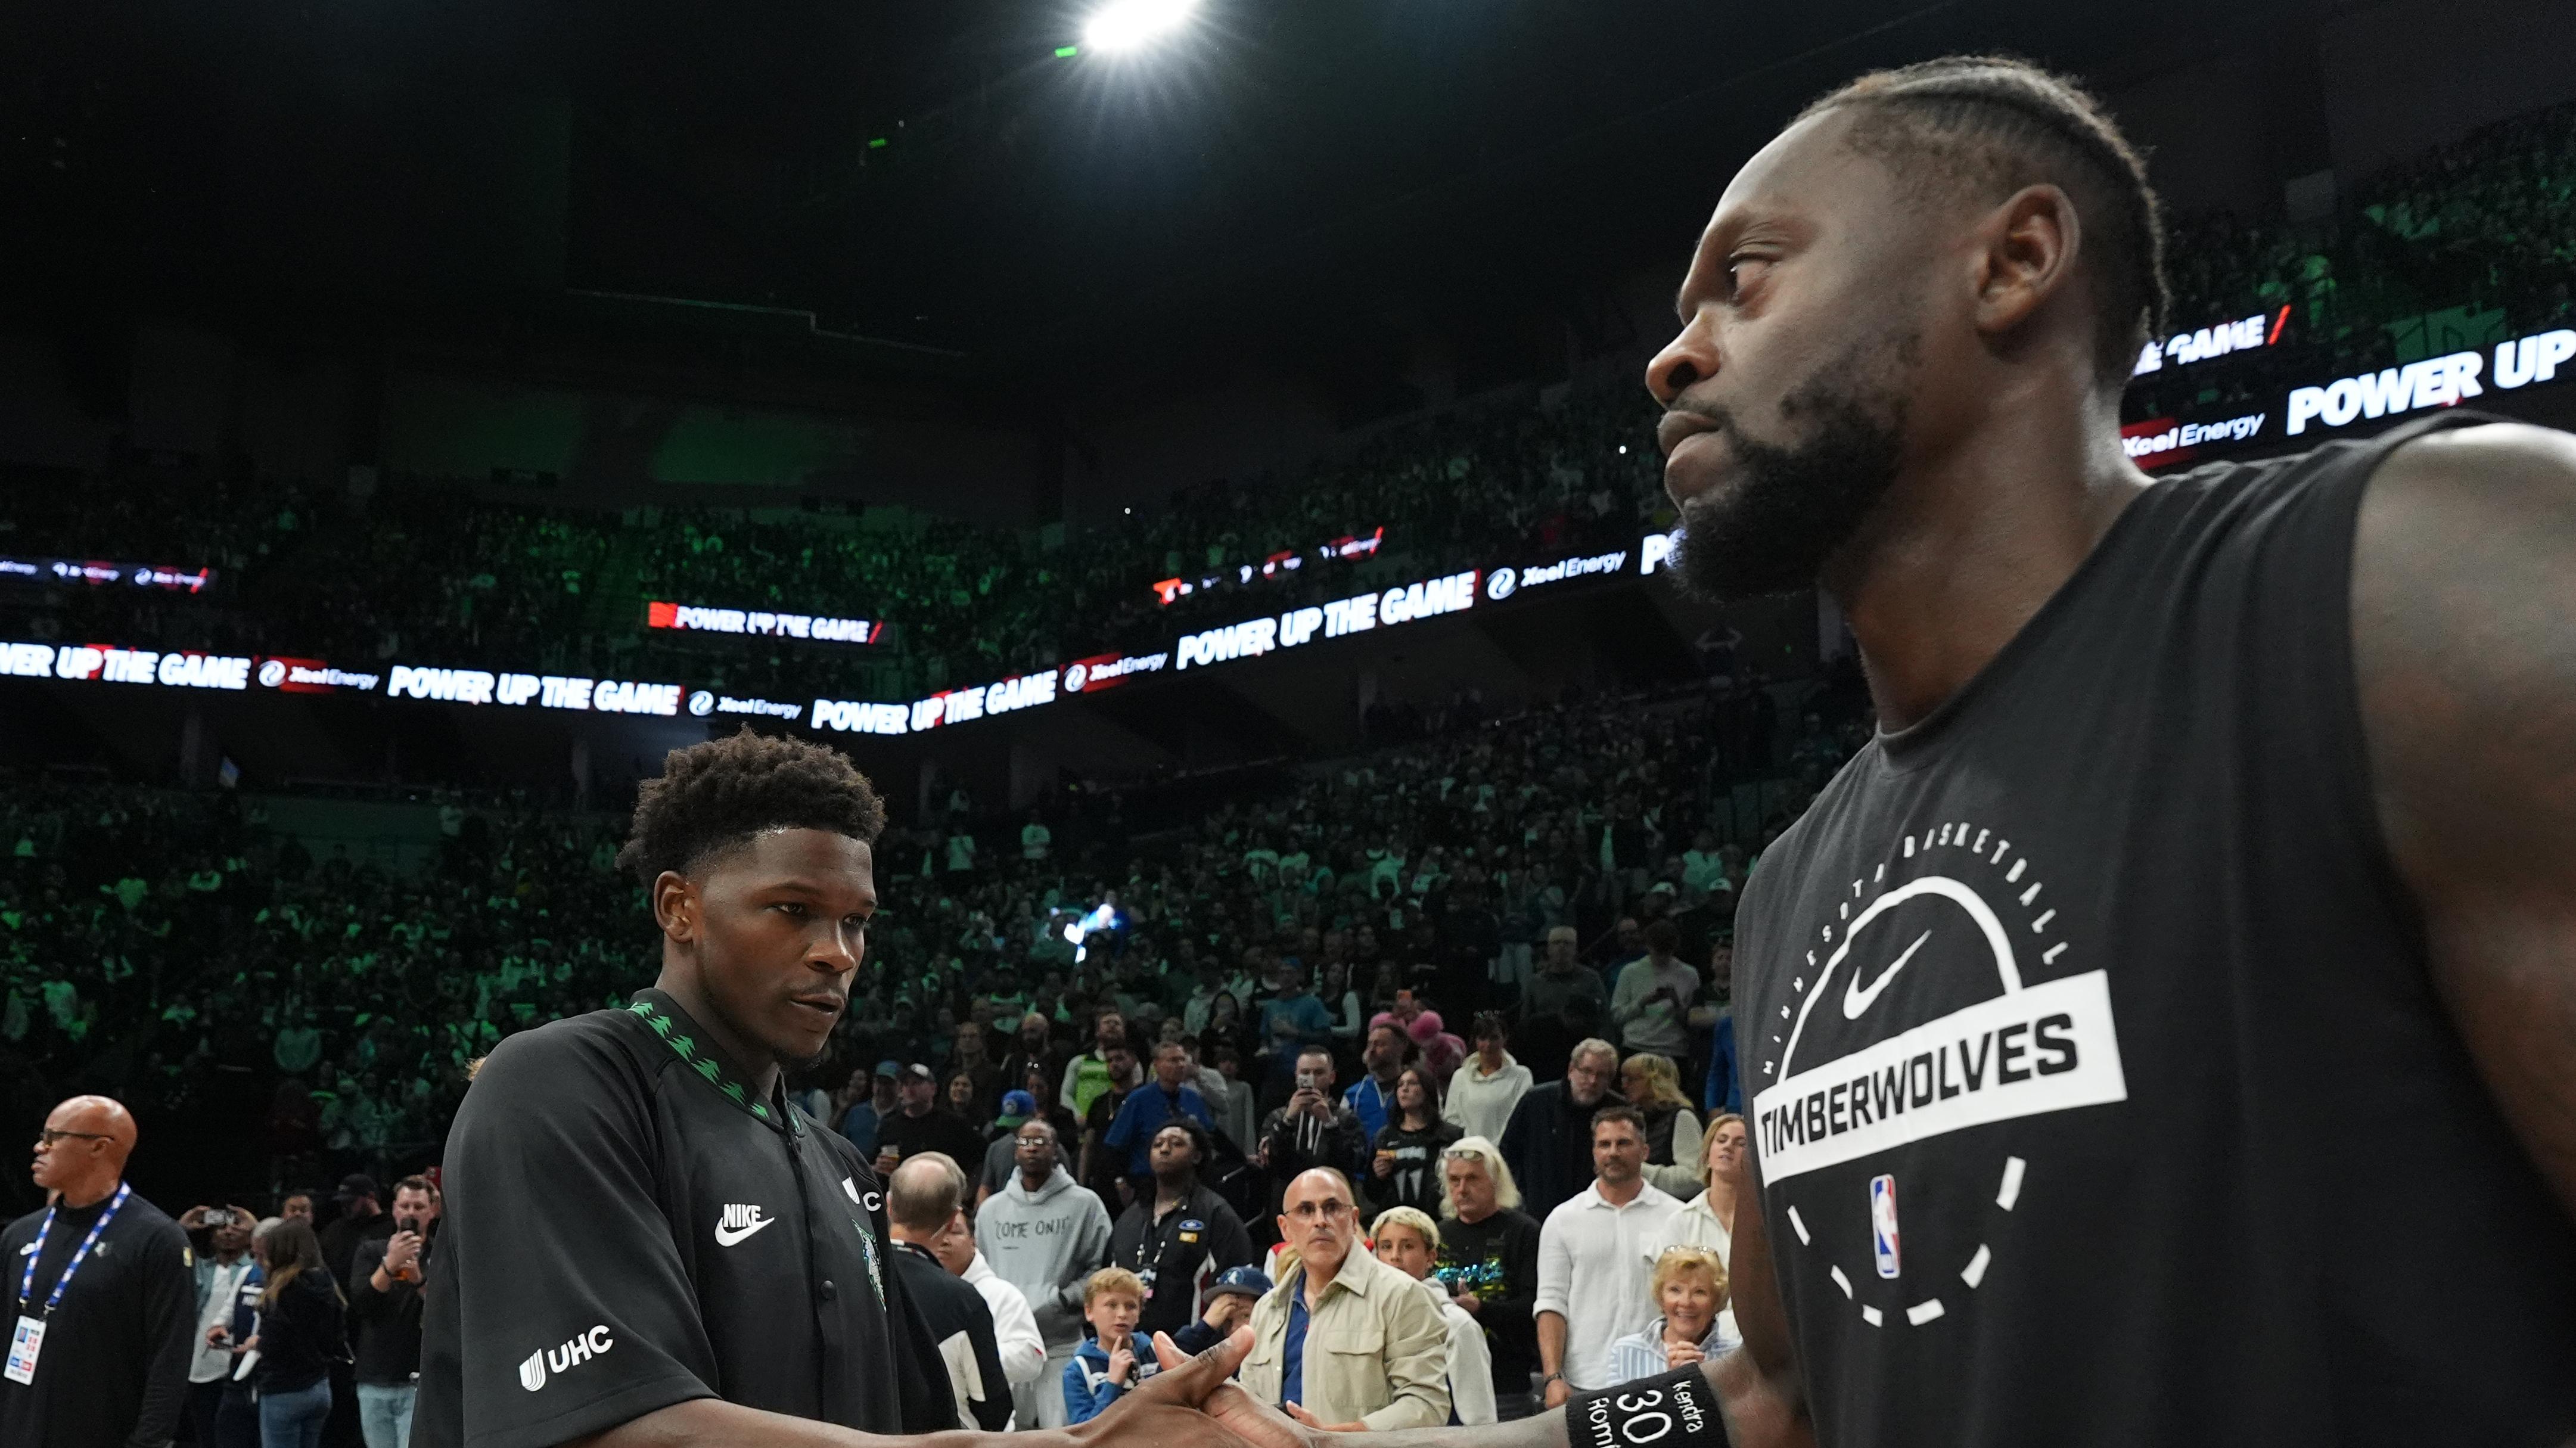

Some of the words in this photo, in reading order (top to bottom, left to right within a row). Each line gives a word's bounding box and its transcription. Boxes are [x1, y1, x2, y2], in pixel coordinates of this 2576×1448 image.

[2165, 315, 2266, 365] GAME
[2286, 352, 2484, 436] POWER
[2494, 330, 2576, 389] UP
[674, 606, 747, 633] POWER
[810, 617, 870, 643] GAME
[1176, 617, 1277, 670] POWER
[1279, 607, 1323, 647] UP
[1323, 593, 1379, 638] THE
[1379, 571, 1475, 625] GAME
[56, 646, 104, 679] UP
[102, 649, 160, 683] THE
[158, 653, 251, 689] GAME
[387, 666, 495, 703] POWER
[496, 673, 540, 705] UP
[540, 676, 593, 709] THE
[593, 680, 680, 715] GAME
[811, 699, 909, 735] POWER
[909, 697, 943, 732] UP
[943, 687, 987, 724] THE
[985, 670, 1058, 714] GAME
[1761, 1012, 2078, 1158] TIMBERWOLVES
[723, 1203, 762, 1228] NIKE
[547, 1325, 614, 1374] UHC
[1616, 1390, 1672, 1444] 30
[1672, 1379, 1704, 1434] Kendra
